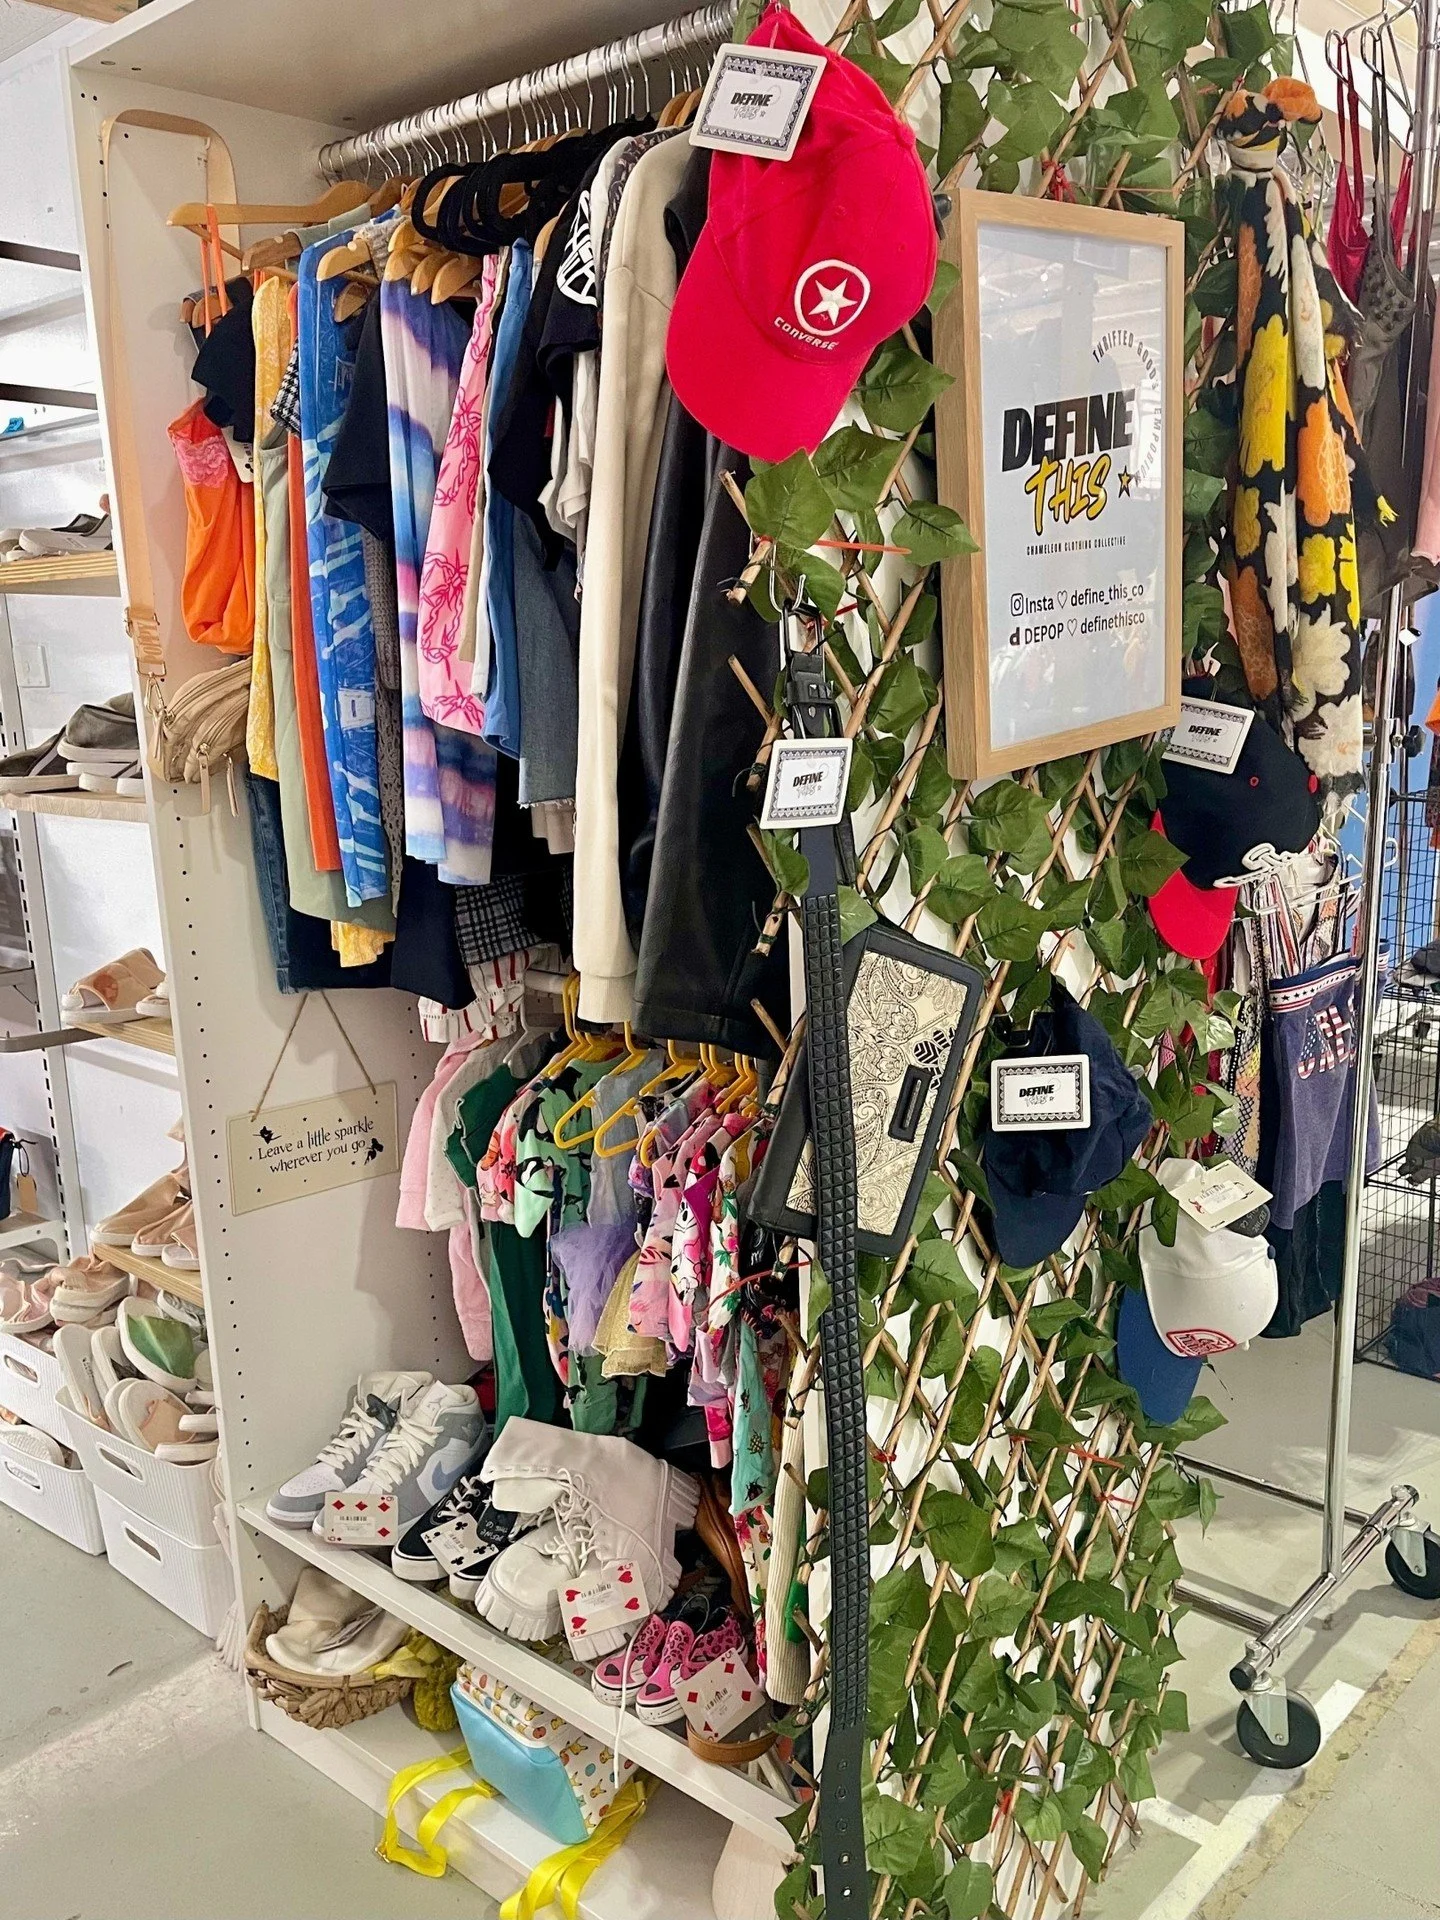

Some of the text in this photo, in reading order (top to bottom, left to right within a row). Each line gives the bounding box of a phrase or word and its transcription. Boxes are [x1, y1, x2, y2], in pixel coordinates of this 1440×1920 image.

[731, 92, 773, 106] DEFINE
[773, 316, 839, 351] CONVERSE
[1092, 329, 1134, 363] THRIFTED
[1002, 388, 1135, 472] DEFINE
[1024, 453, 1112, 537] THIS
[1026, 535, 1127, 556] CHAMELEON CLOTHING COLLECTIVE
[1025, 584, 1144, 614] Insta define_this_co
[1024, 622, 1064, 645] DEPOP
[1080, 611, 1145, 634] definethisco
[1188, 725, 1222, 736] DEFINE
[793, 771, 823, 787] DEFINE
[1019, 1084, 1055, 1097] DEFINE
[258, 1115, 374, 1160] Leave a little sparkle
[270, 1139, 366, 1173] wherever you go
